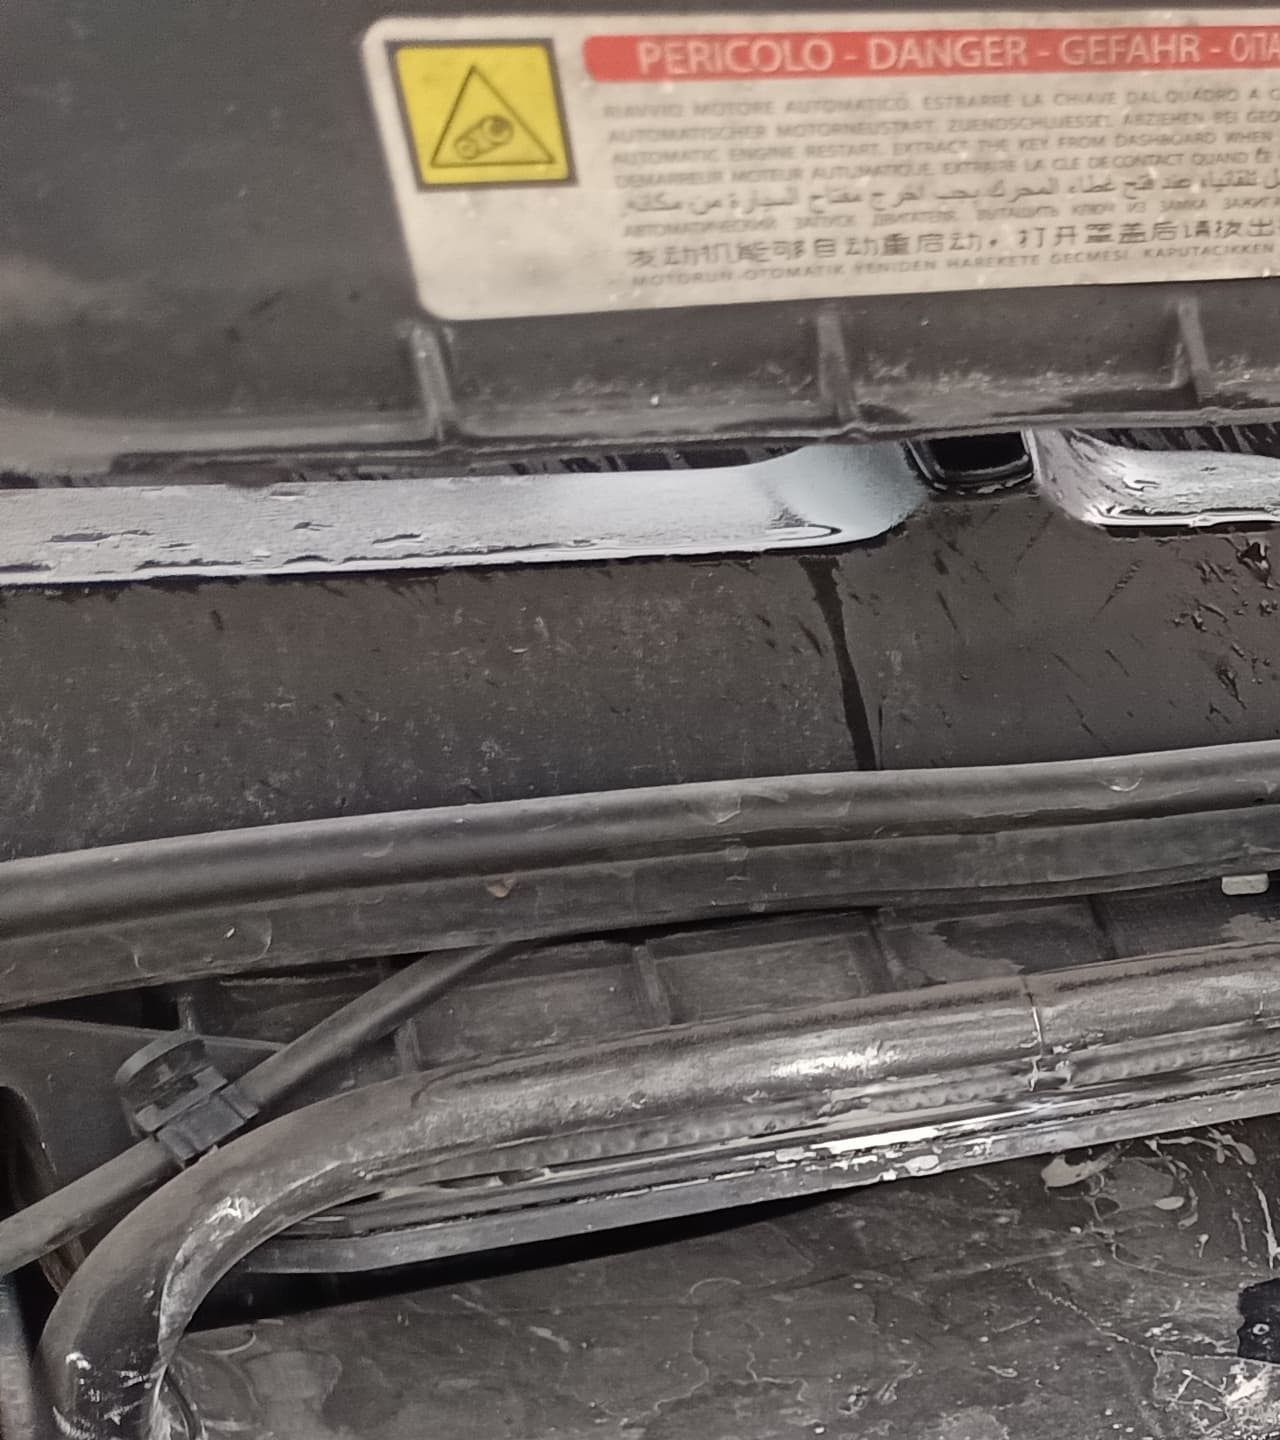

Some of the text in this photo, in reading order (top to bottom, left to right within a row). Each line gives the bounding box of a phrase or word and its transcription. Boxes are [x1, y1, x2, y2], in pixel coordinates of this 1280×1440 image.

[637, 36, 833, 74] PERICOLO
[868, 34, 1029, 71] DANGER
[1059, 32, 1200, 66] GEFAHR
[729, 146, 794, 162] ENGINE
[978, 139, 1010, 153] THE
[1018, 137, 1049, 152] KEY
[1058, 135, 1106, 150] FROM
[1226, 129, 1273, 145] WHEN
